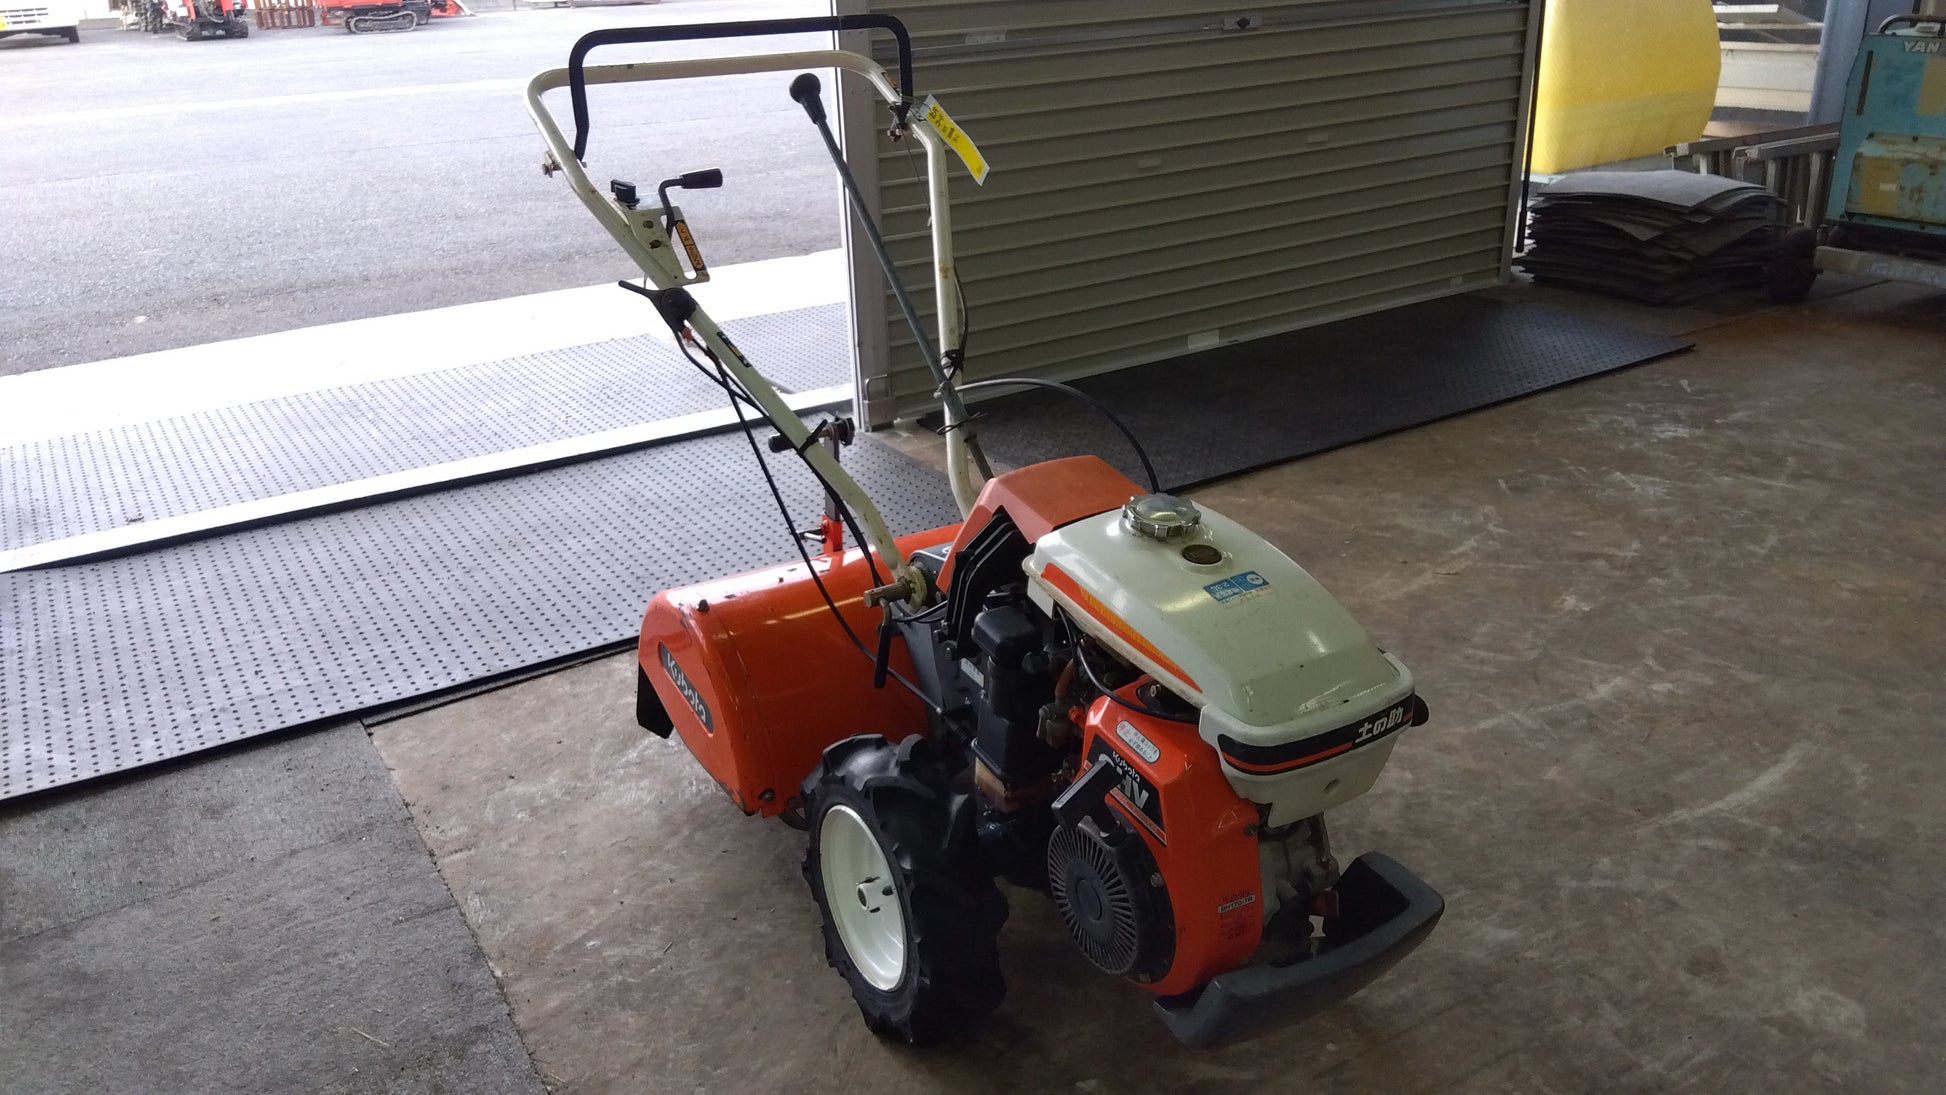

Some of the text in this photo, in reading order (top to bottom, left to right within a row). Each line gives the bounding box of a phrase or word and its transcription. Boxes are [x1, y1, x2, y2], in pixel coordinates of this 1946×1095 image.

[667, 652, 706, 723] Kubota
[1355, 706, 1404, 744] 土の助
[1112, 751, 1140, 782] Kubota
